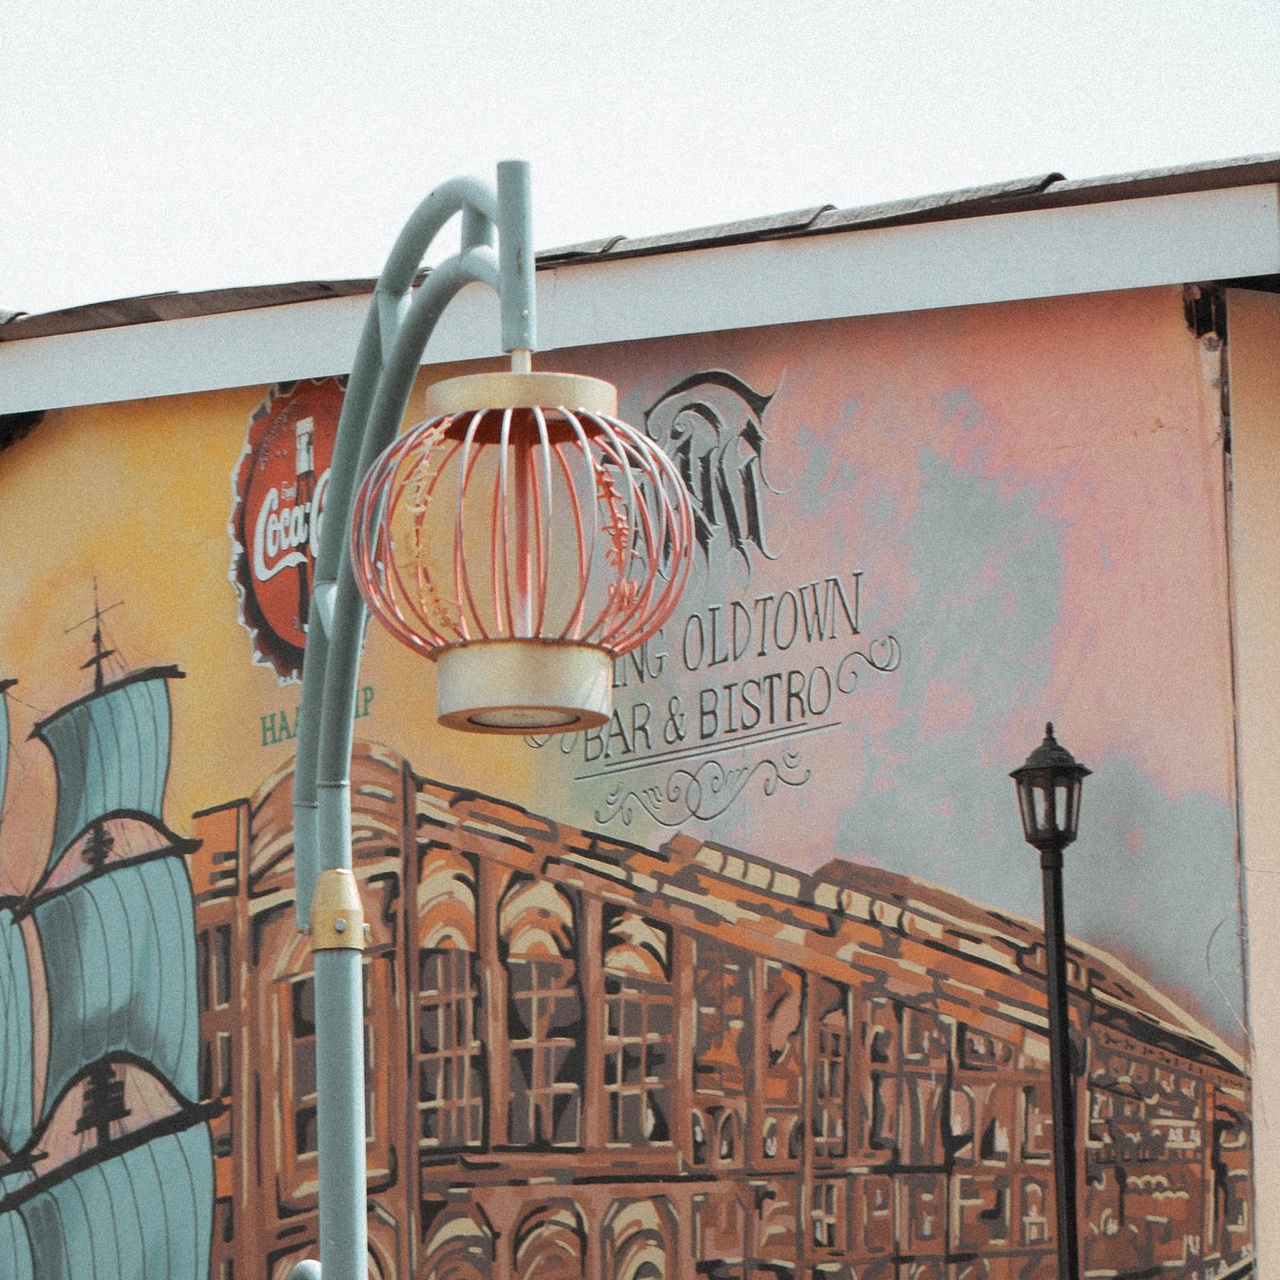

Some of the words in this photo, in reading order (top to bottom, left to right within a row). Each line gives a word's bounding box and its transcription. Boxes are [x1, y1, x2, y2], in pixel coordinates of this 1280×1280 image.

[683, 570, 863, 671] OLDTOWN
[663, 695, 686, 745] &
[699, 666, 831, 740] BISTRO
